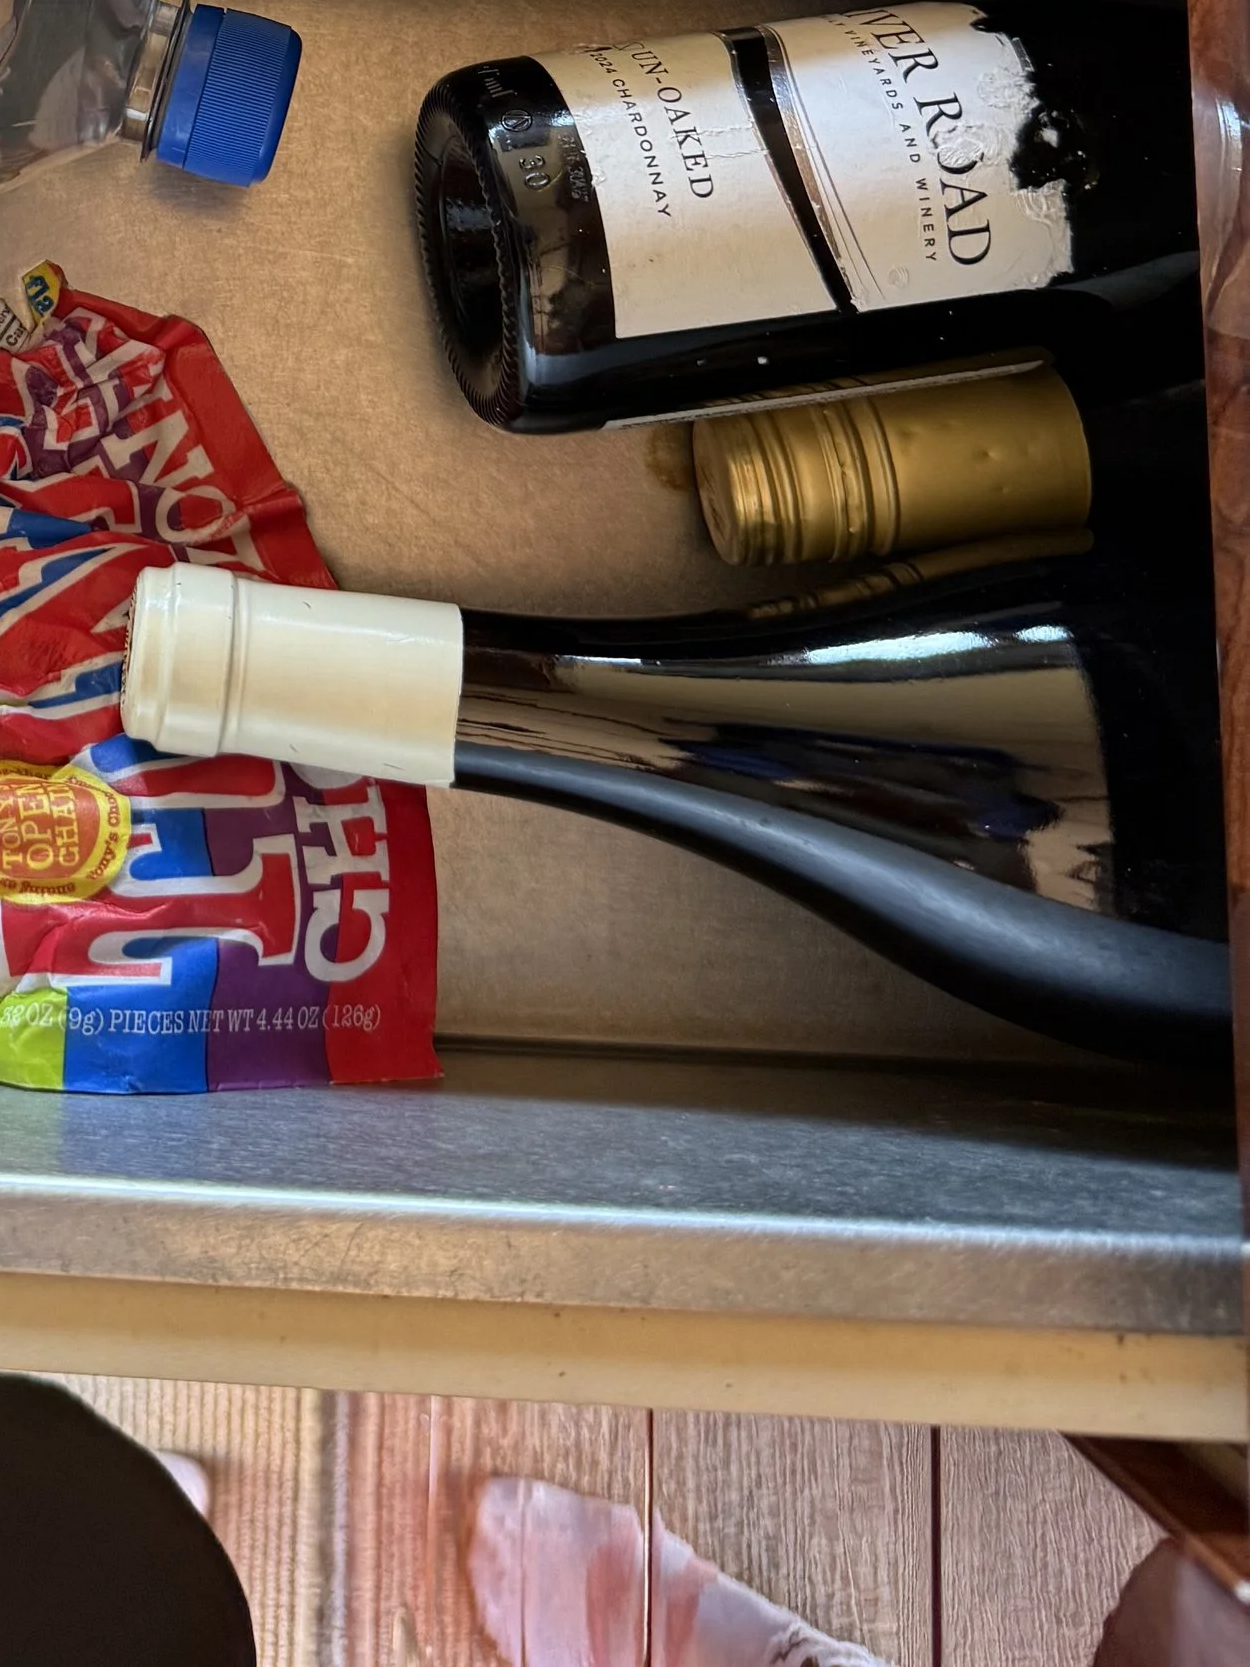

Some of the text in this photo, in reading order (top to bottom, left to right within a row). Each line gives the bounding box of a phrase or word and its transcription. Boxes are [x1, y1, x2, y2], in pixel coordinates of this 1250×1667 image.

[588, 50, 672, 221] 2024 CHARDONNAY
[840, 28, 939, 265] VINEYARDS AND WINERY
[841, 2, 998, 271] IVER ROAD
[16, 783, 54, 870] OPEN
[46, 784, 79, 866] CHAIN
[58, 1008, 104, 1036] (9g)
[107, 1007, 185, 1035] PIECES
[189, 1008, 223, 1033] NET
[225, 1006, 253, 1032] WT
[255, 1006, 294, 1031] 4.44
[296, 1005, 319, 1026] OZ
[321, 1003, 381, 1032] (126g)
